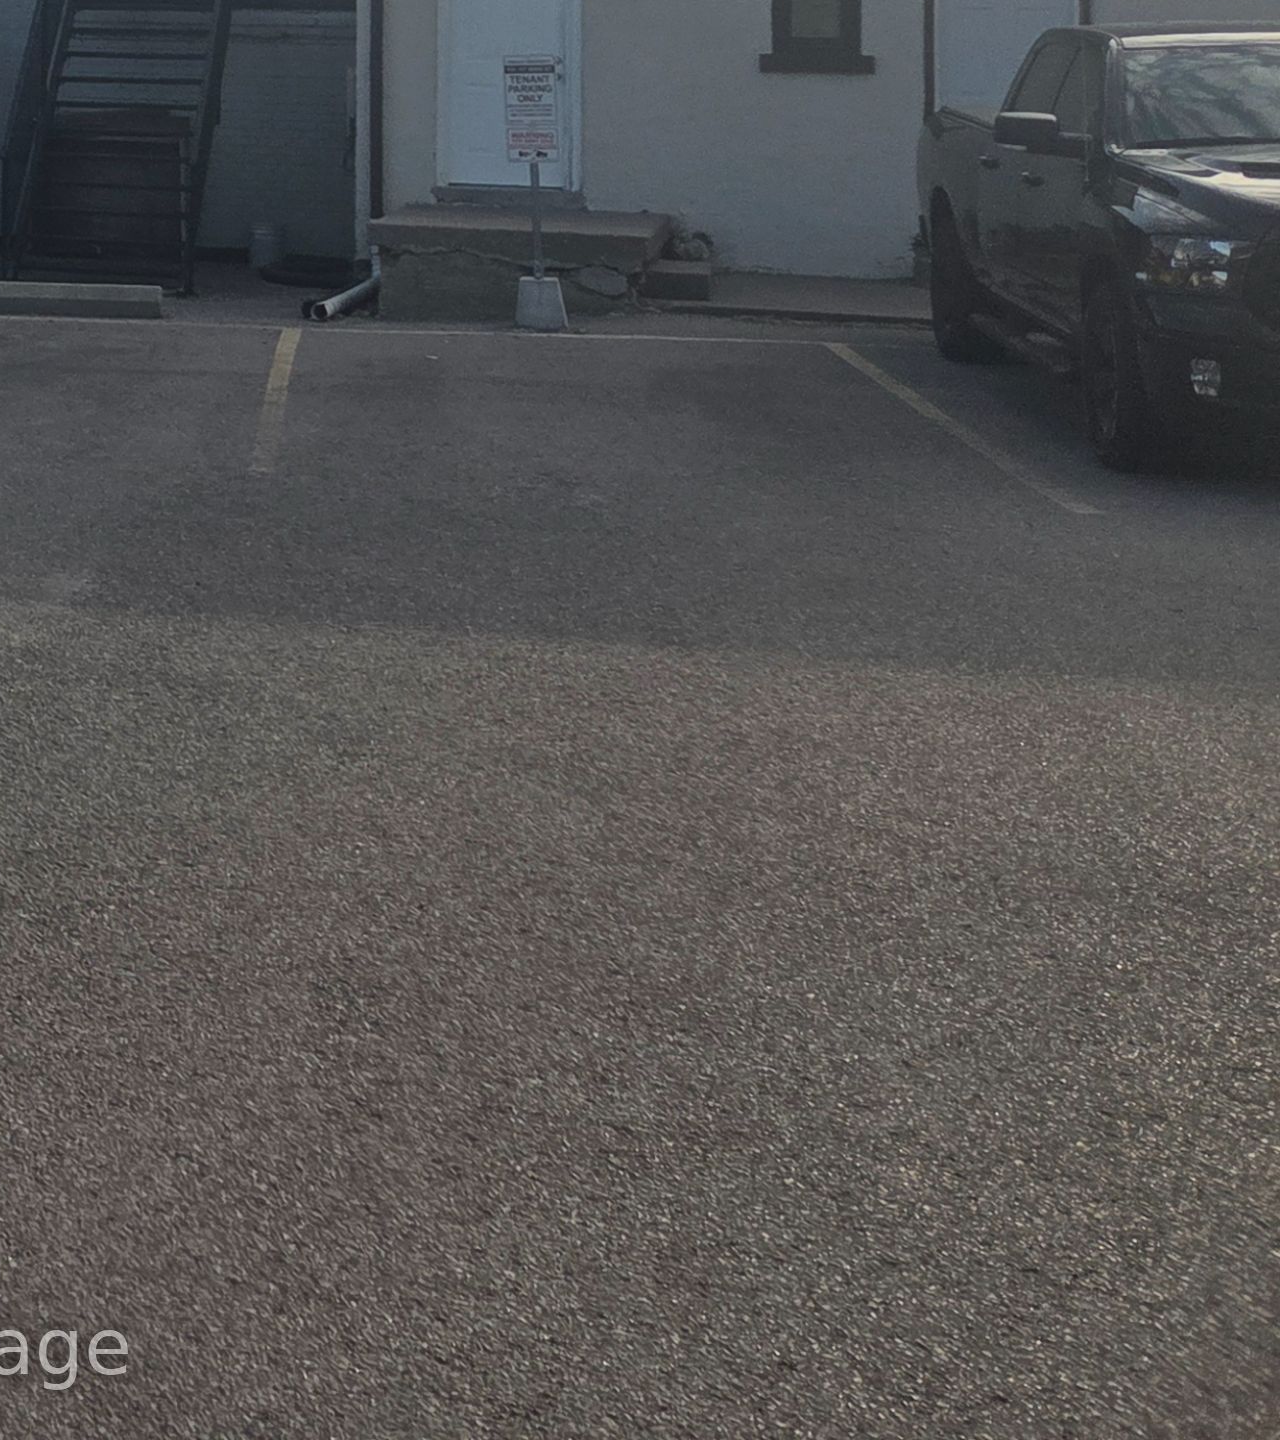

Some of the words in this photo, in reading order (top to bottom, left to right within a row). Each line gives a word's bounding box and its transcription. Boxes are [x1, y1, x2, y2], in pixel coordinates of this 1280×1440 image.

[509, 74, 551, 85] TENANT
[507, 84, 553, 94] PARKING
[517, 94, 544, 103] ONLY
